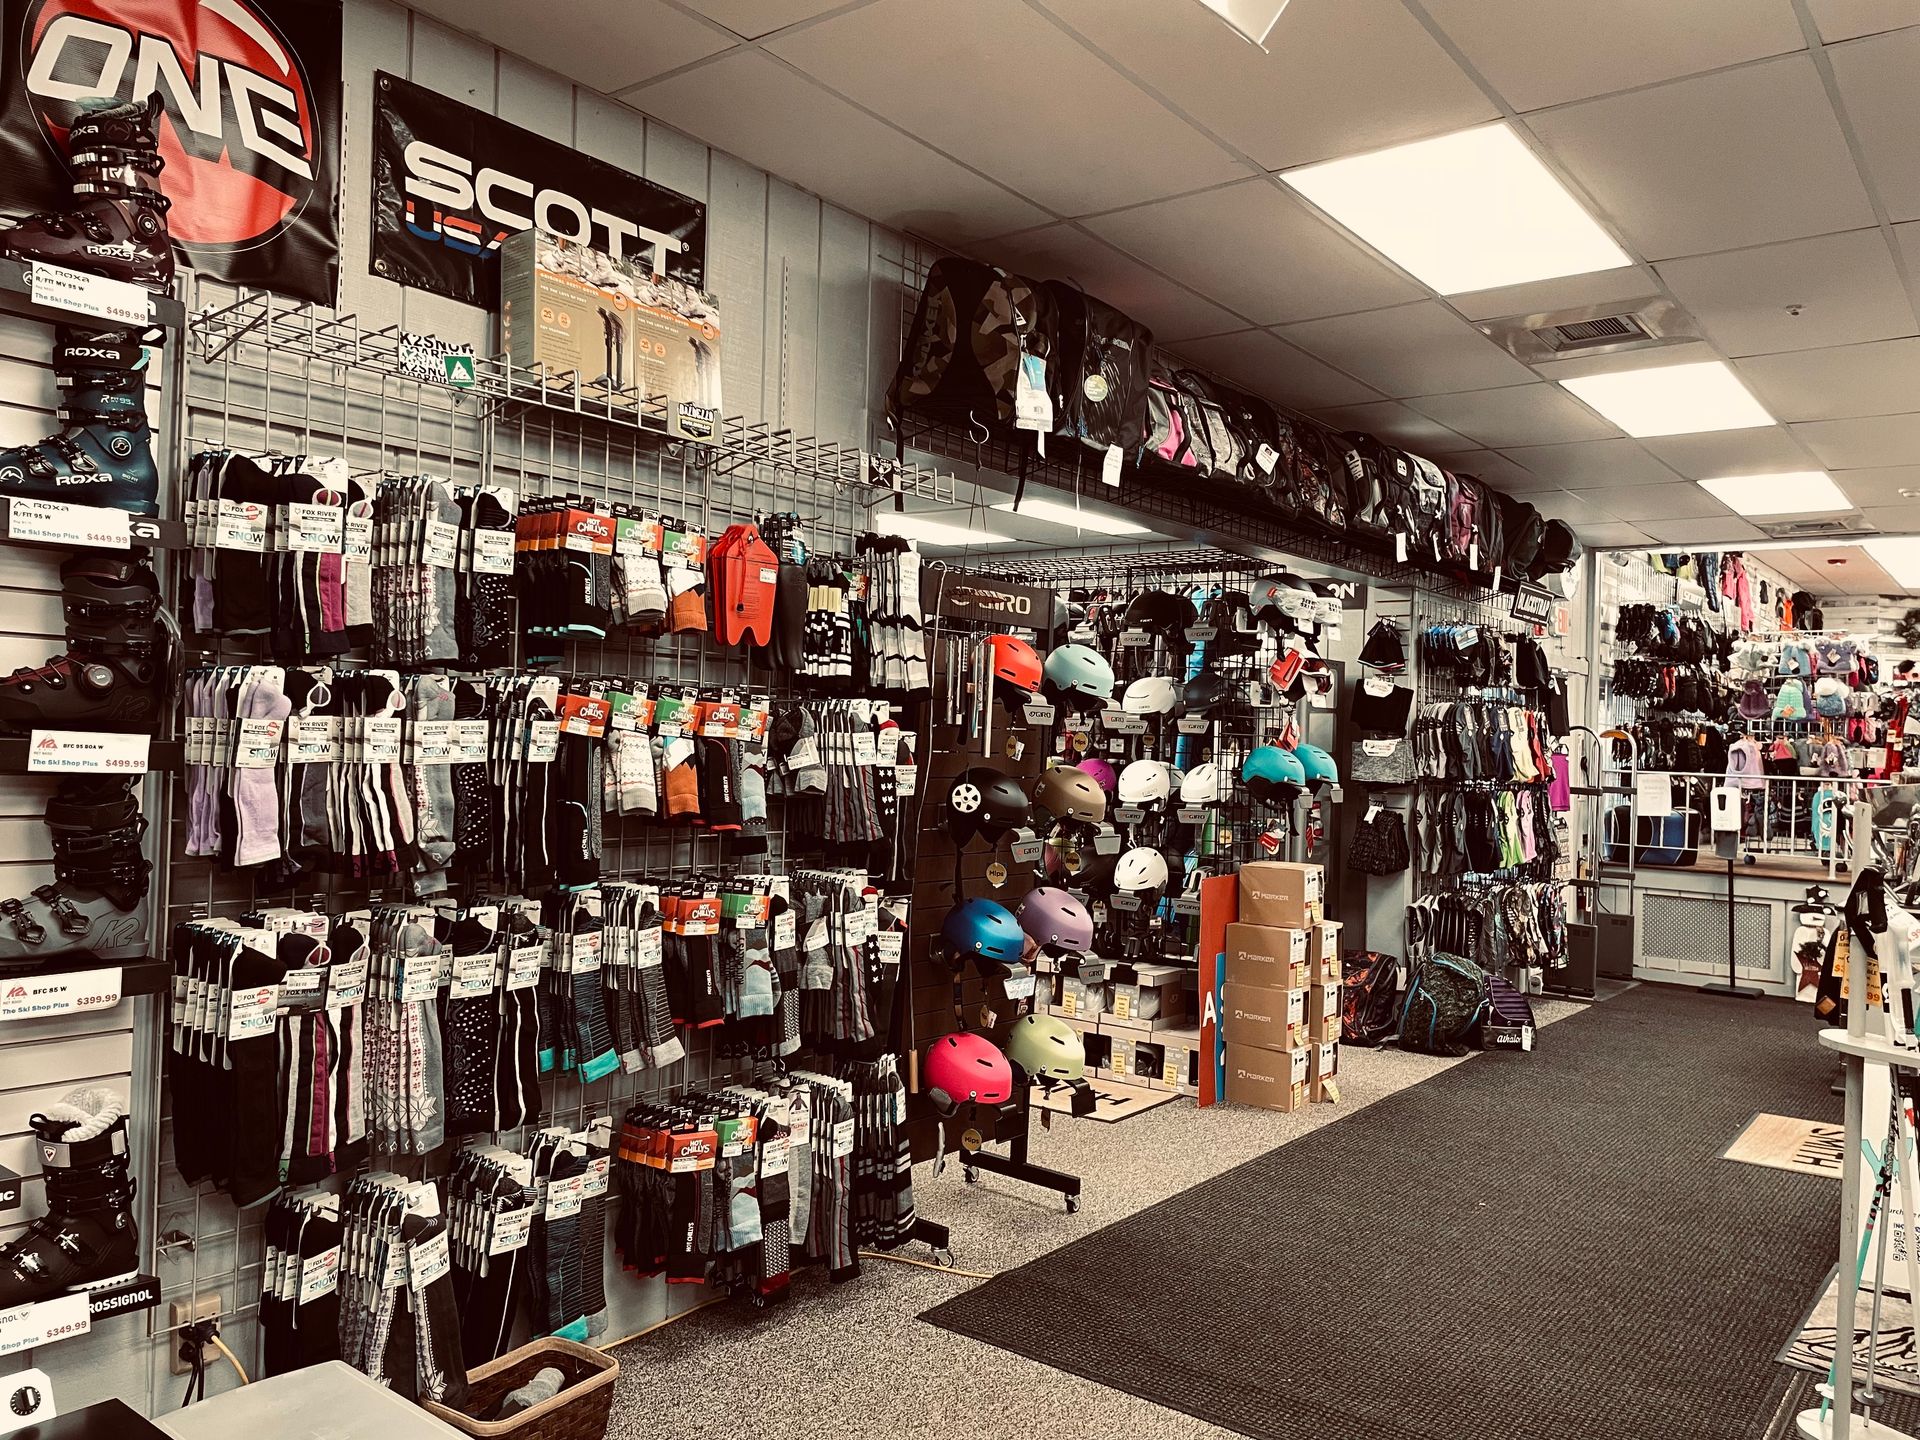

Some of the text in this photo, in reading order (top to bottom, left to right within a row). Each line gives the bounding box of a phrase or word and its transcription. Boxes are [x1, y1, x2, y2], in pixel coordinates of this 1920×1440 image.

[27, 15, 314, 181] ONE
[404, 140, 682, 277] SCOTT
[55, 270, 90, 283] ROXA
[35, 292, 100, 312] The Ski Shop Plus
[106, 306, 146, 321] $499.99
[65, 347, 121, 360] ROXA
[56, 473, 113, 486] ROXA
[33, 502, 69, 512] ROXA
[302, 509, 337, 518] FOX RIVER
[586, 517, 600, 526] HOT
[13, 527, 79, 540] The Ski Shop Plus
[577, 522, 608, 537] CHILLYS
[87, 533, 128, 544] $449.99
[228, 531, 264, 543] SNOW
[300, 532, 341, 544] SNOW
[482, 556, 513, 566] SNOW
[579, 706, 604, 720] CHILLYS
[712, 711, 735, 721] CHILLYS
[249, 748, 278, 758] SNOW
[298, 744, 331, 754] SNOW
[372, 745, 398, 755] SNOW
[422, 747, 451, 756] SNOW
[460, 746, 487, 754] SNOW
[62, 759, 80, 767] Shop
[105, 759, 145, 768] $499.99
[1261, 892, 1289, 901] MARKER
[691, 908, 716, 919] CHILLYS
[1246, 954, 1275, 963] MARKER
[514, 970, 539, 981] SNOW
[460, 979, 492, 990] SNOW
[285, 988, 299, 996] FOX
[336, 986, 365, 1000] SNOW
[76, 993, 118, 1006] $399.99
[31, 1004, 51, 1012] Shop
[240, 1014, 275, 1029] SNOW
[1243, 1013, 1271, 1022] MARKER
[1246, 1072, 1275, 1083] MARKER
[689, 1139, 703, 1147] HOT
[681, 1143, 711, 1157] CHILLYS
[554, 1198, 581, 1211] SNOW
[513, 1212, 528, 1220] RIVER
[499, 1231, 528, 1245] SNOW
[421, 1256, 449, 1277] SNOW
[310, 1273, 337, 1292] SNOW
[88, 1289, 154, 1314] ROSSIGNOL
[46, 1320, 87, 1338] $349.99
[1, 1336, 40, 1351] Shop Plus
